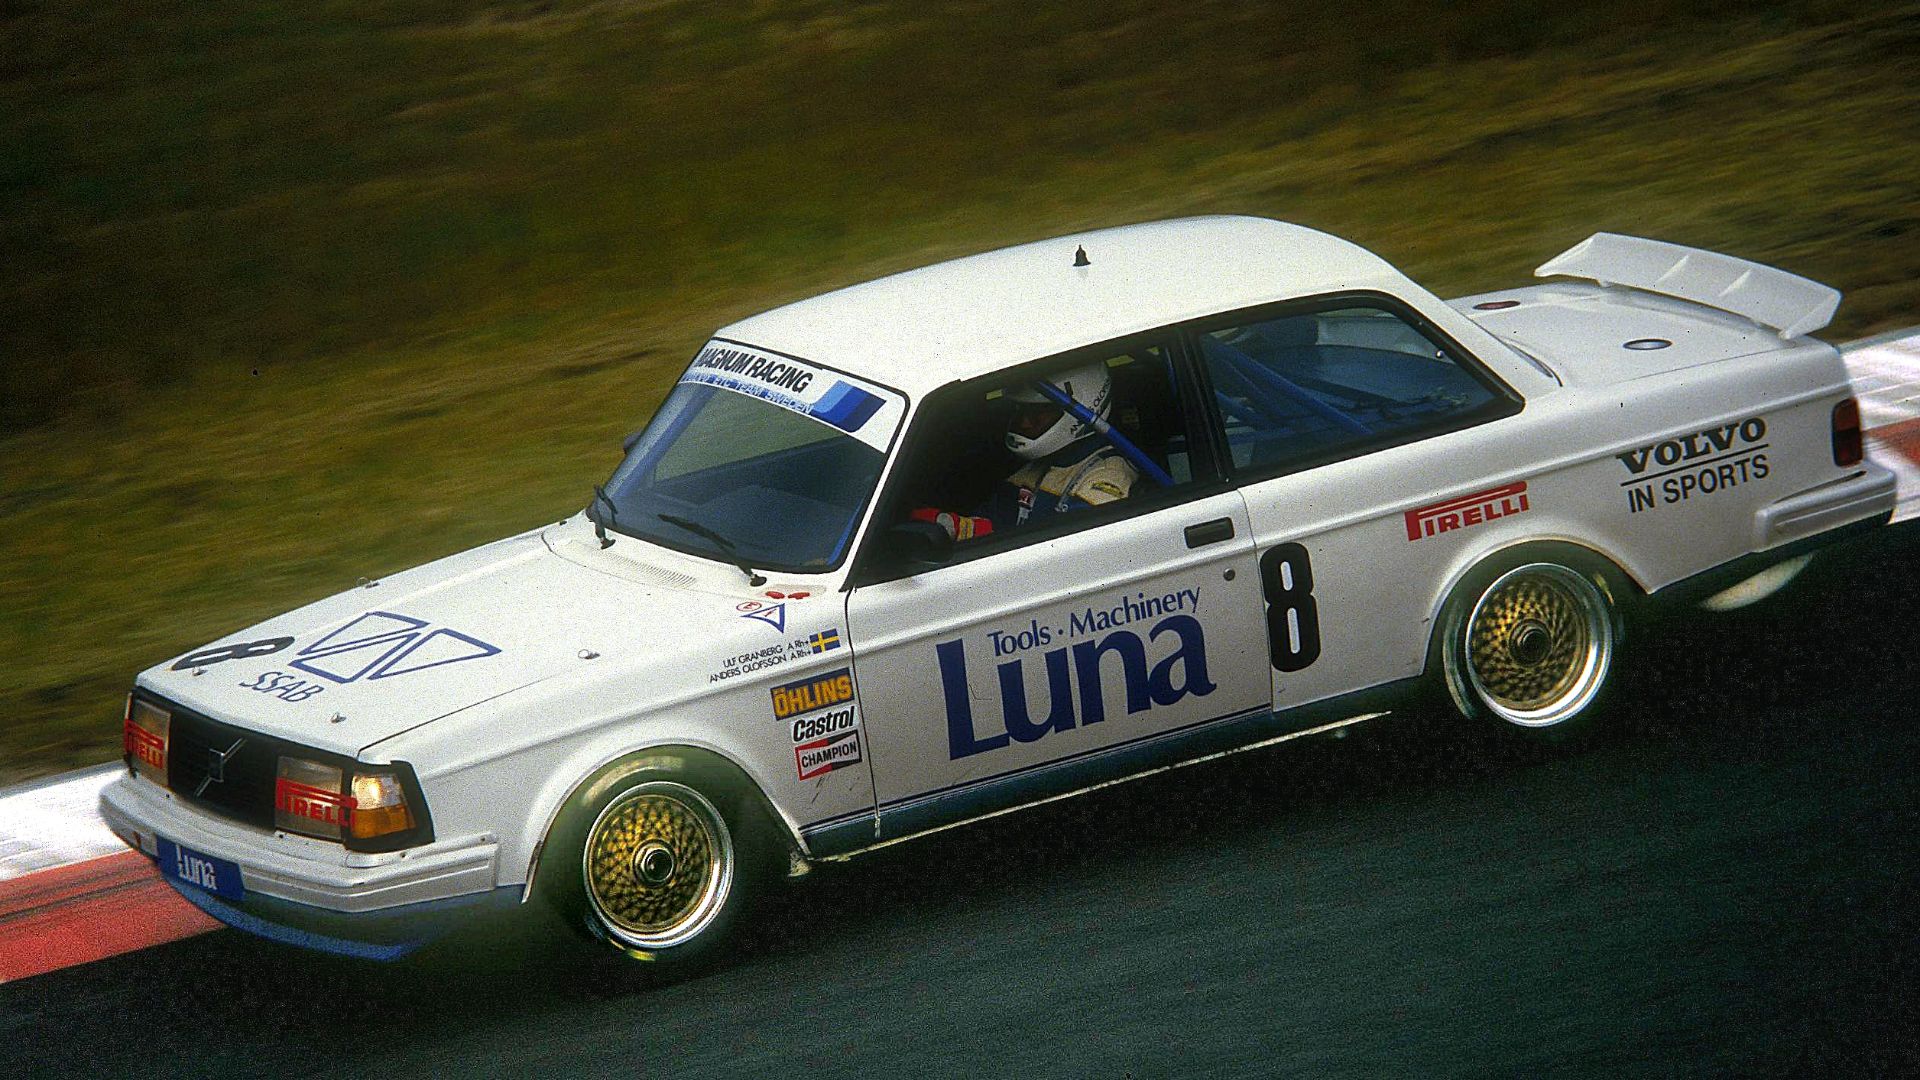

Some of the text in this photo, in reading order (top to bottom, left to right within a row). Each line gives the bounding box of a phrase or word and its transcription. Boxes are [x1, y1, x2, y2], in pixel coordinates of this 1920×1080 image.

[692, 348, 814, 394] MAGNUM RACING
[764, 388, 815, 415] SWEDEN
[1615, 417, 1767, 475] VOLVO
[1628, 454, 1770, 513] IN SPORTS
[1404, 480, 1529, 541] PIRELLI
[987, 586, 1201, 657] Tools Machinery
[1260, 542, 1322, 673] 8
[171, 635, 296, 671] 8
[709, 666, 742, 683] ANDERS
[742, 654, 787, 674] OLOFSSON
[723, 656, 737, 668] ULF
[738, 644, 783, 664] GRANBERG
[239, 671, 326, 702] SSAB
[773, 674, 853, 718] ÖHLINS
[935, 614, 1218, 761] Luna
[793, 705, 855, 742] Castrol
[801, 741, 857, 768] CHAMPION
[276, 777, 358, 832] PIRELLI
[175, 843, 218, 891] Luna
